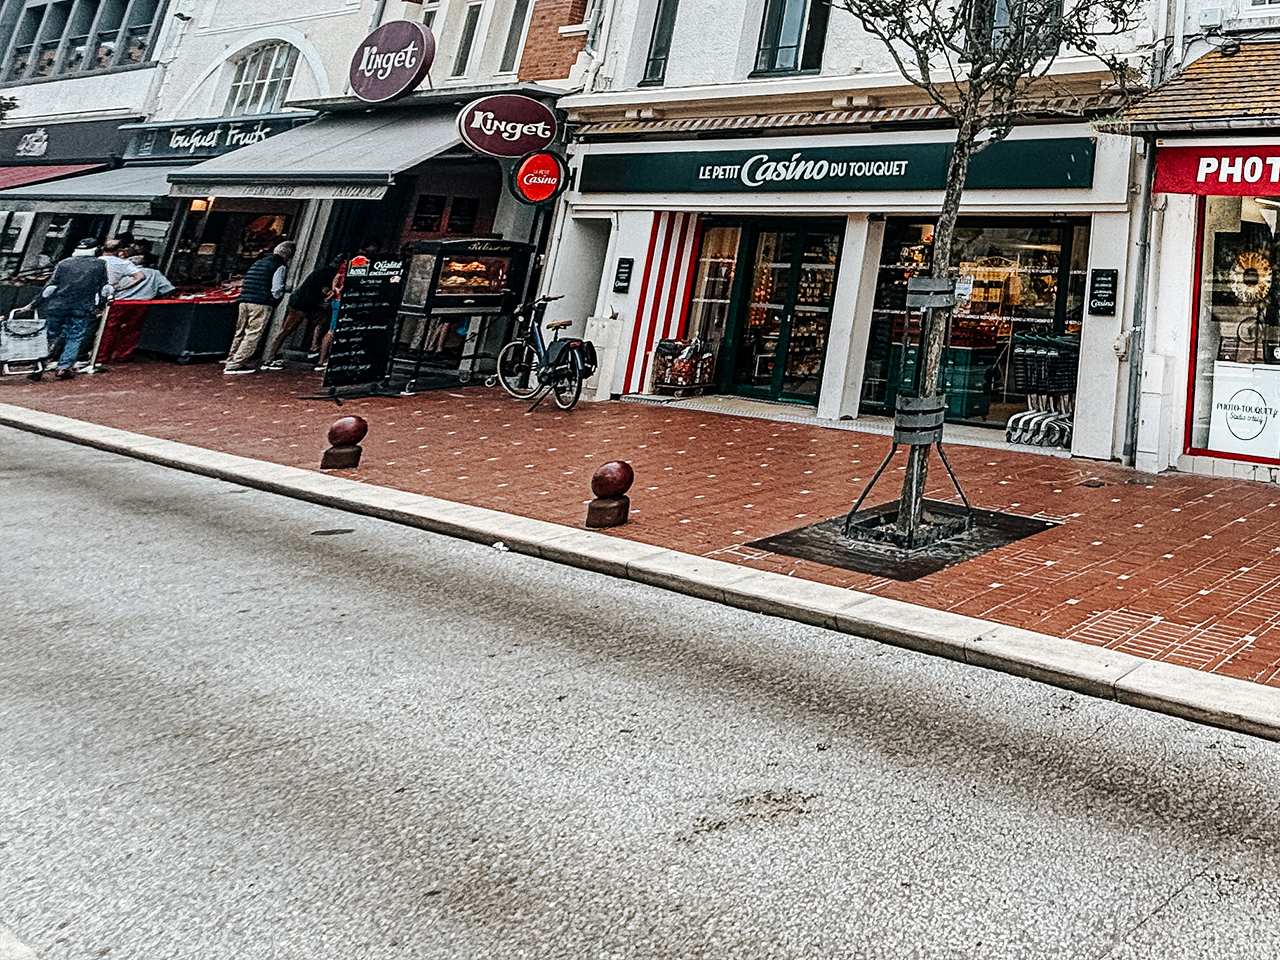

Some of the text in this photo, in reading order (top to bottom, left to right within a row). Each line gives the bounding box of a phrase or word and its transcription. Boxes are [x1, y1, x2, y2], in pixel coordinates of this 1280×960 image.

[169, 120, 272, 154] Touquet Fruits
[523, 173, 557, 185] Casino
[699, 153, 909, 187] LE PETIT Casino DU TOUQUET
[1091, 299, 1114, 308] Casino
